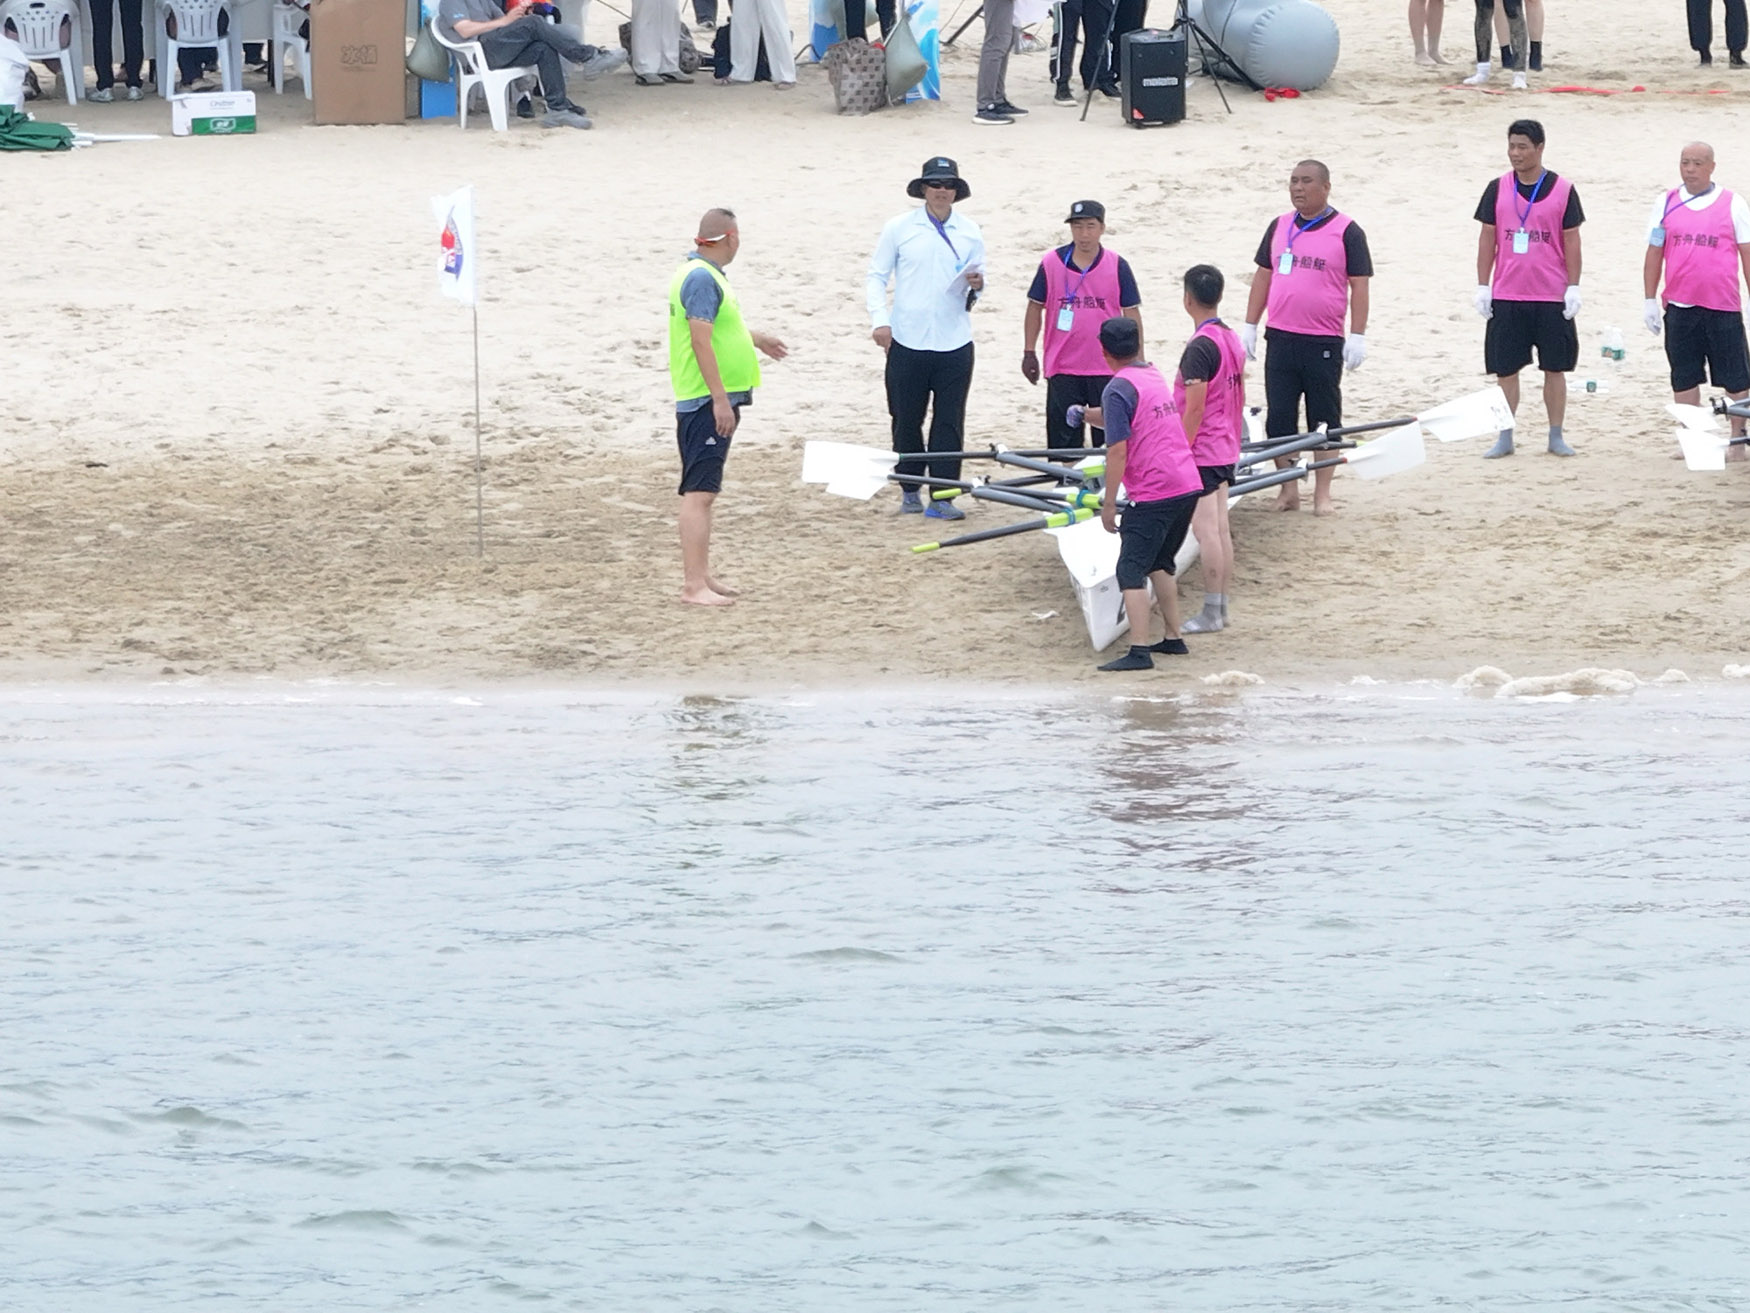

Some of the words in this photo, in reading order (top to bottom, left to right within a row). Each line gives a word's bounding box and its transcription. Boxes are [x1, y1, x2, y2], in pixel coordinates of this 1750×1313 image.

[1504, 228, 1551, 244] 方船艇
[1673, 233, 1719, 248] 方舟船艇
[1277, 254, 1326, 271] 舟船艇
